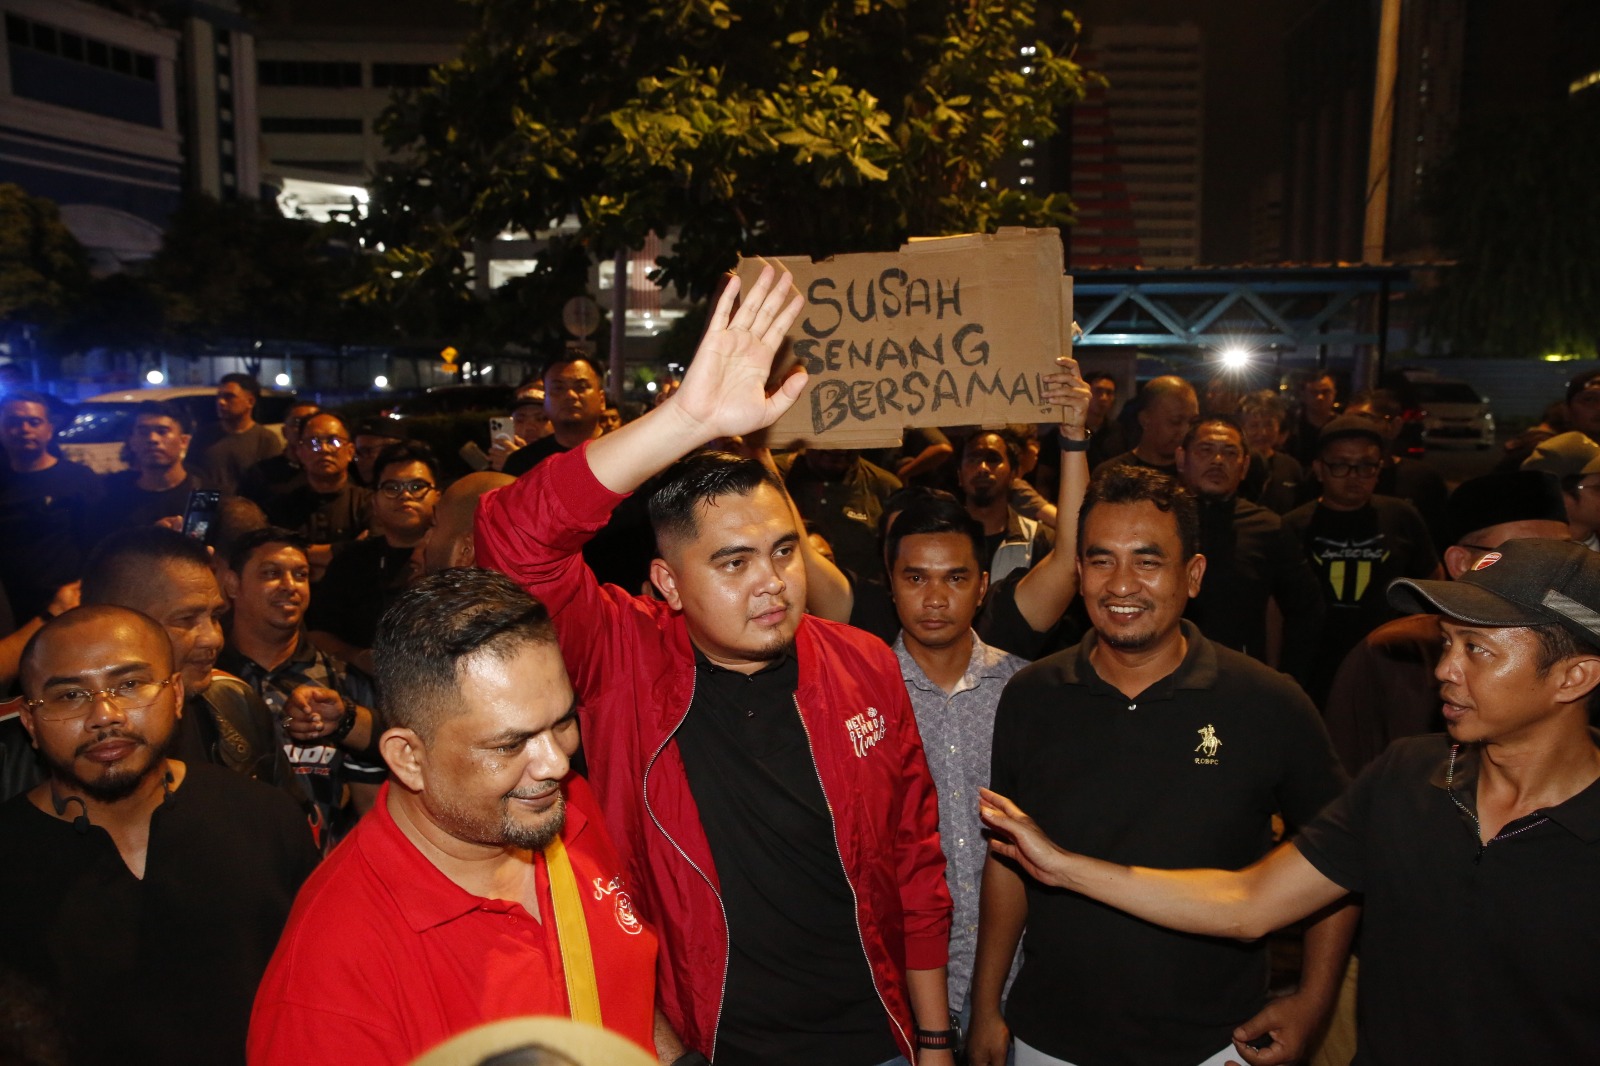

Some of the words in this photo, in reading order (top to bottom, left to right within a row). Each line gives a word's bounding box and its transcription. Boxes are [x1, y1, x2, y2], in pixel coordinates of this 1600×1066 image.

[801, 267, 962, 339] SUSAH
[792, 323, 990, 375] SENANG
[850, 714, 885, 742] PEMUDA
